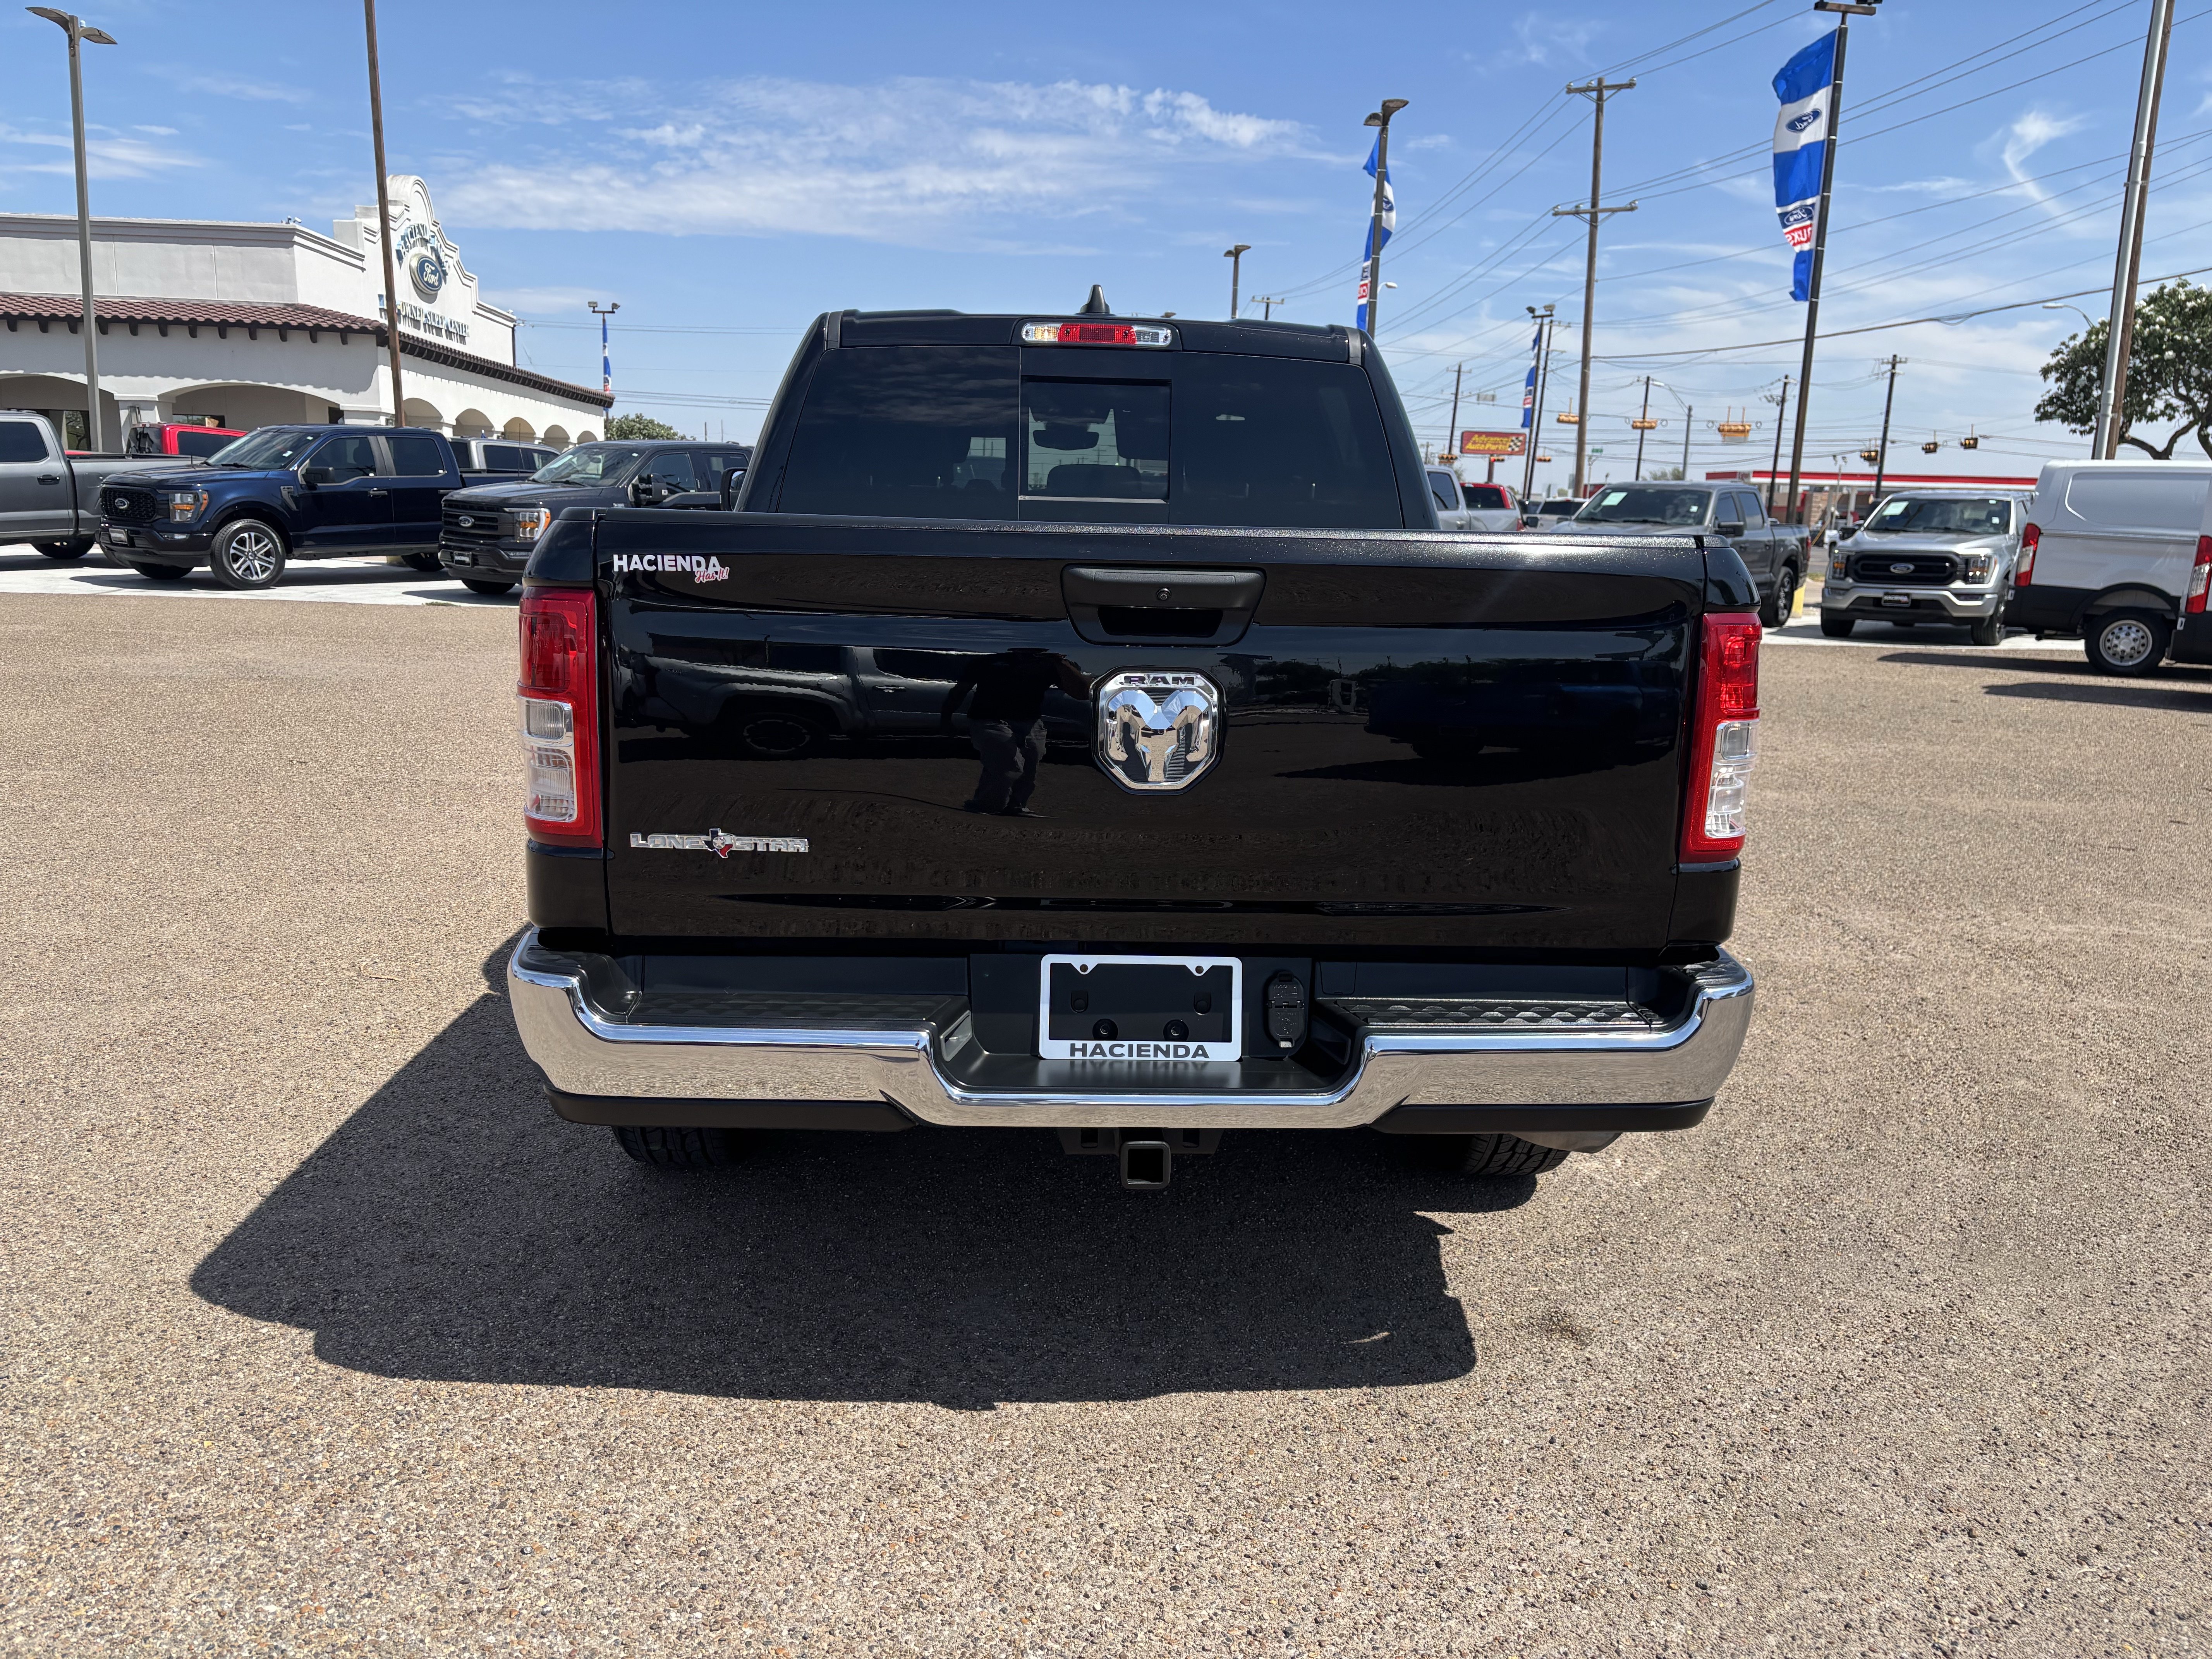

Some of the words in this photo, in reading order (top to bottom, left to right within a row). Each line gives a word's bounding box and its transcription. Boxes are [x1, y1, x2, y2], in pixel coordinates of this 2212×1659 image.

[423, 262, 439, 286] Ford
[613, 554, 721, 572] HACIENDA
[696, 570, 715, 582] Has
[717, 568, 729, 580] It!
[1123, 675, 1195, 685] RAM
[630, 832, 706, 850] LONE
[733, 835, 810, 853] STAR
[1069, 1042, 1210, 1059] HACIENDA
